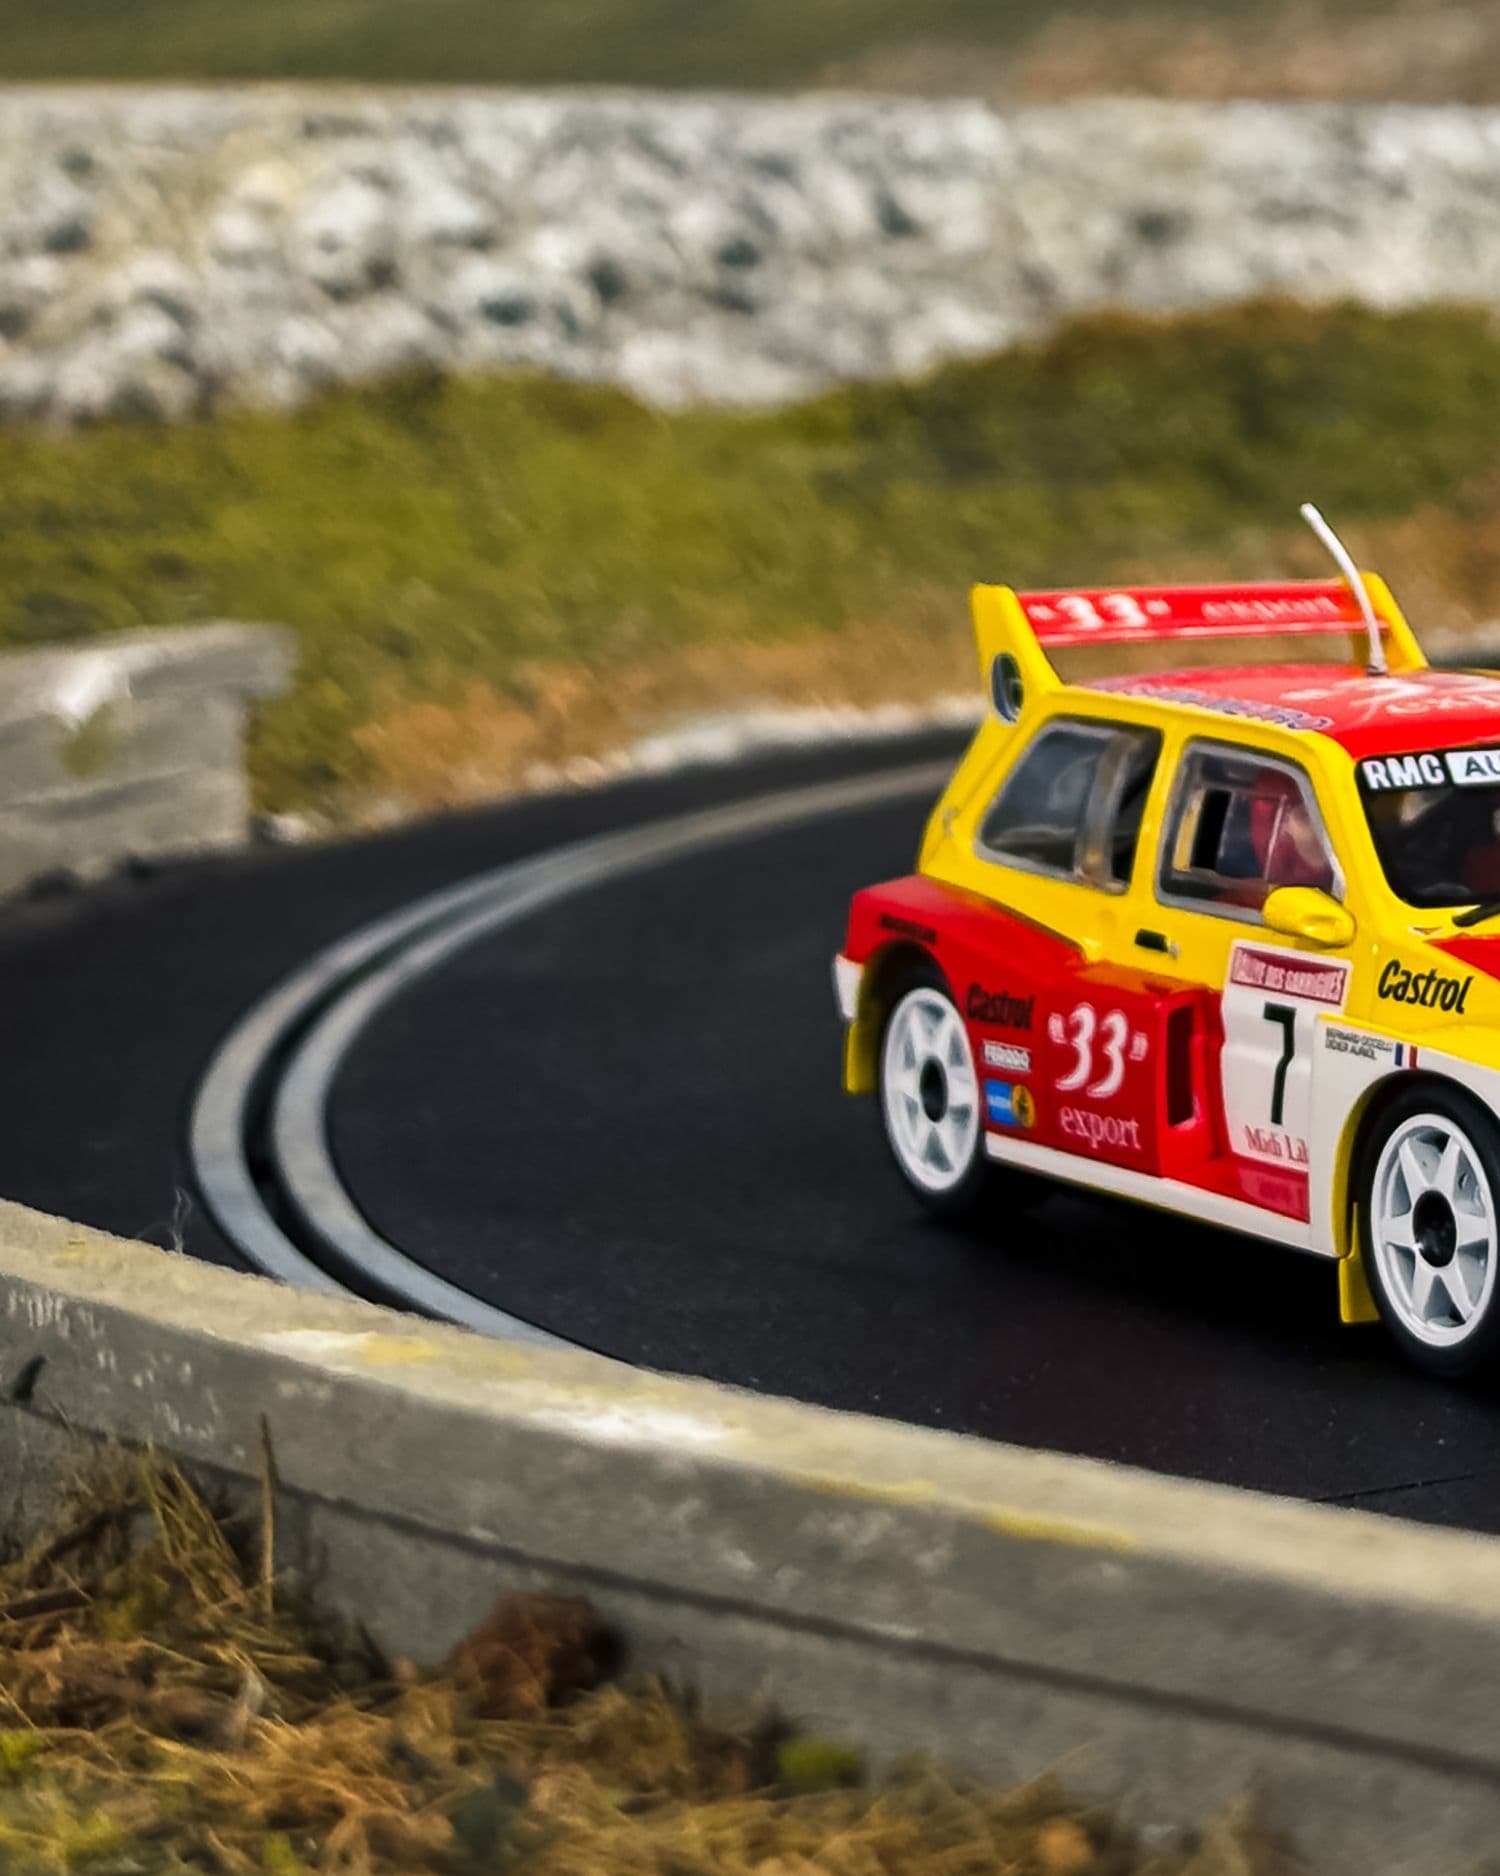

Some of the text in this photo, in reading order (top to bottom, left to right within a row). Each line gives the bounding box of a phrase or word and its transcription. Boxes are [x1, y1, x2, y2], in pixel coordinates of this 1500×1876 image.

[1362, 754, 1446, 789] RMC
[1378, 959, 1475, 1015] Castrol
[1263, 1001, 1297, 1126] 7
[1060, 1105, 1142, 1150] export
